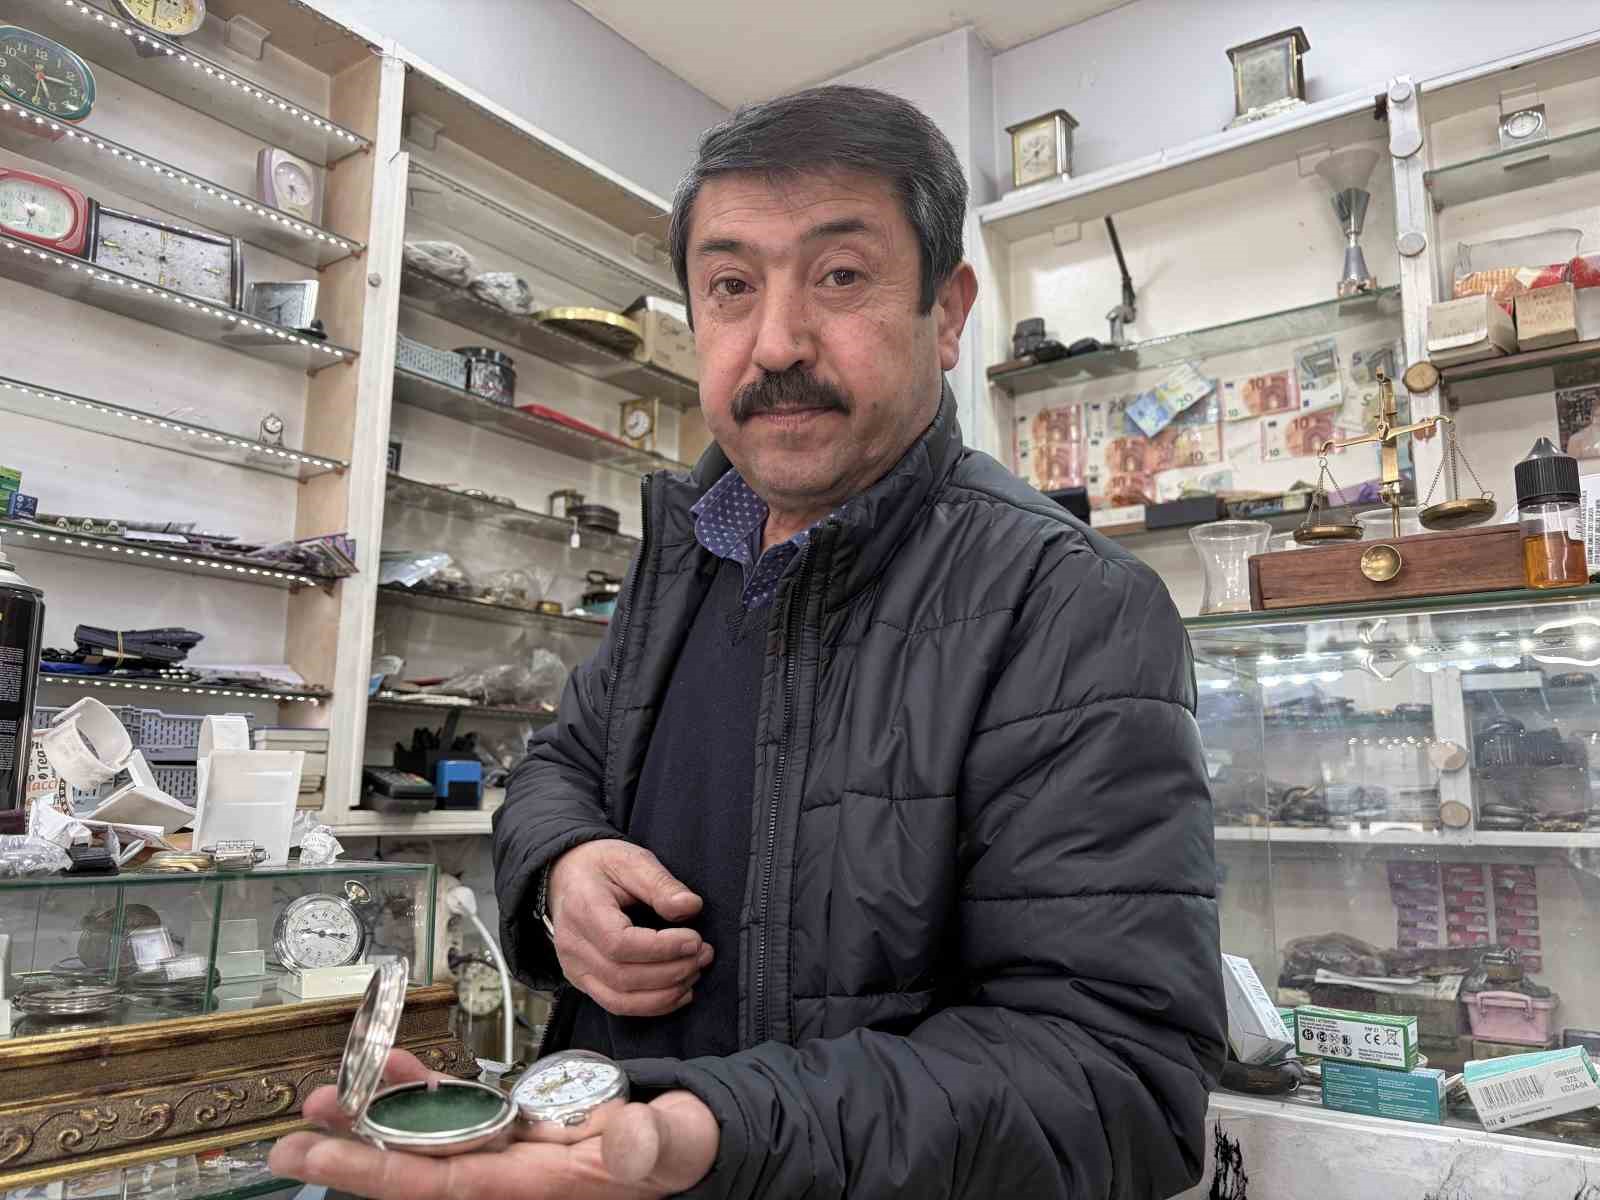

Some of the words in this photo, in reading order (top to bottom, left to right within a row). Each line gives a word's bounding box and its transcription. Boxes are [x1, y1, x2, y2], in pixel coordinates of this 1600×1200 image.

[5, 45, 17, 57] 10
[35, 48, 48, 60] 12
[0, 57, 7, 68] 9
[17, 88, 26, 97] 7
[48, 102, 57, 112] 5
[1250, 378, 1265, 391] 10
[1228, 408, 1239, 417] 10
[1293, 418, 1309, 430] 10
[1190, 451, 1204, 463] 10
[1269, 449, 1280, 457] 10
[1364, 1032, 1381, 1046] CE
